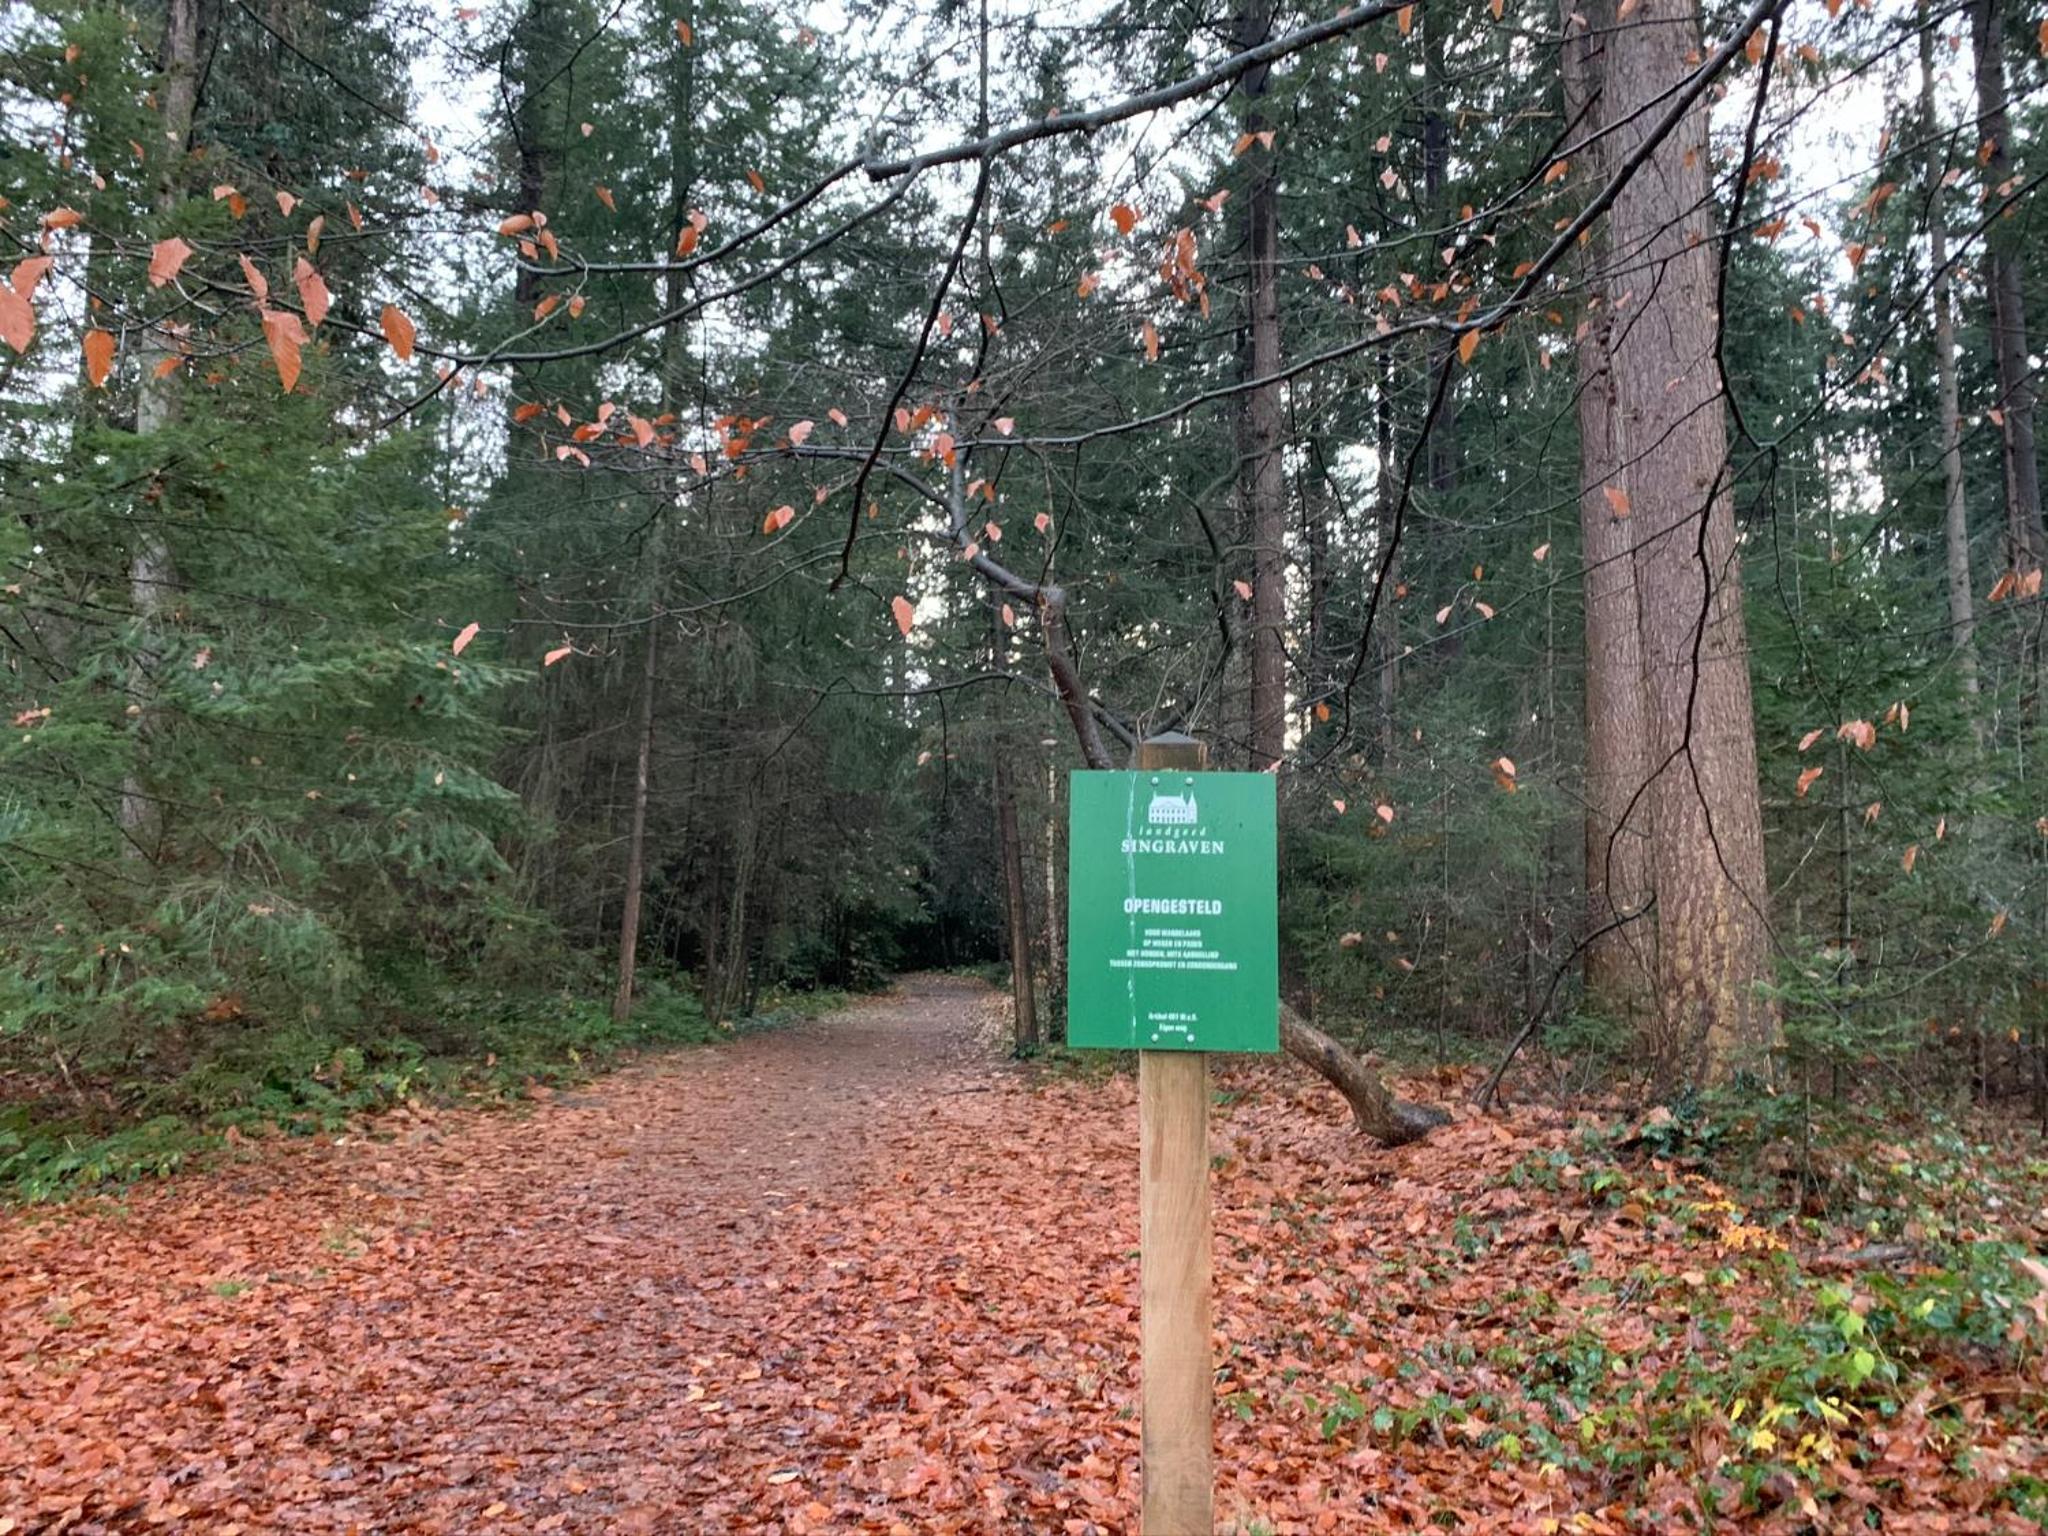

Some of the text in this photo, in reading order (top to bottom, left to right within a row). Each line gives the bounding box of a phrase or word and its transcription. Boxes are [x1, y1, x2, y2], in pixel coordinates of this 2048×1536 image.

[1139, 826, 1207, 839] landgoed
[1121, 839, 1225, 854] SINGRAVEN
[1123, 898, 1222, 915] OPENGESTELD
